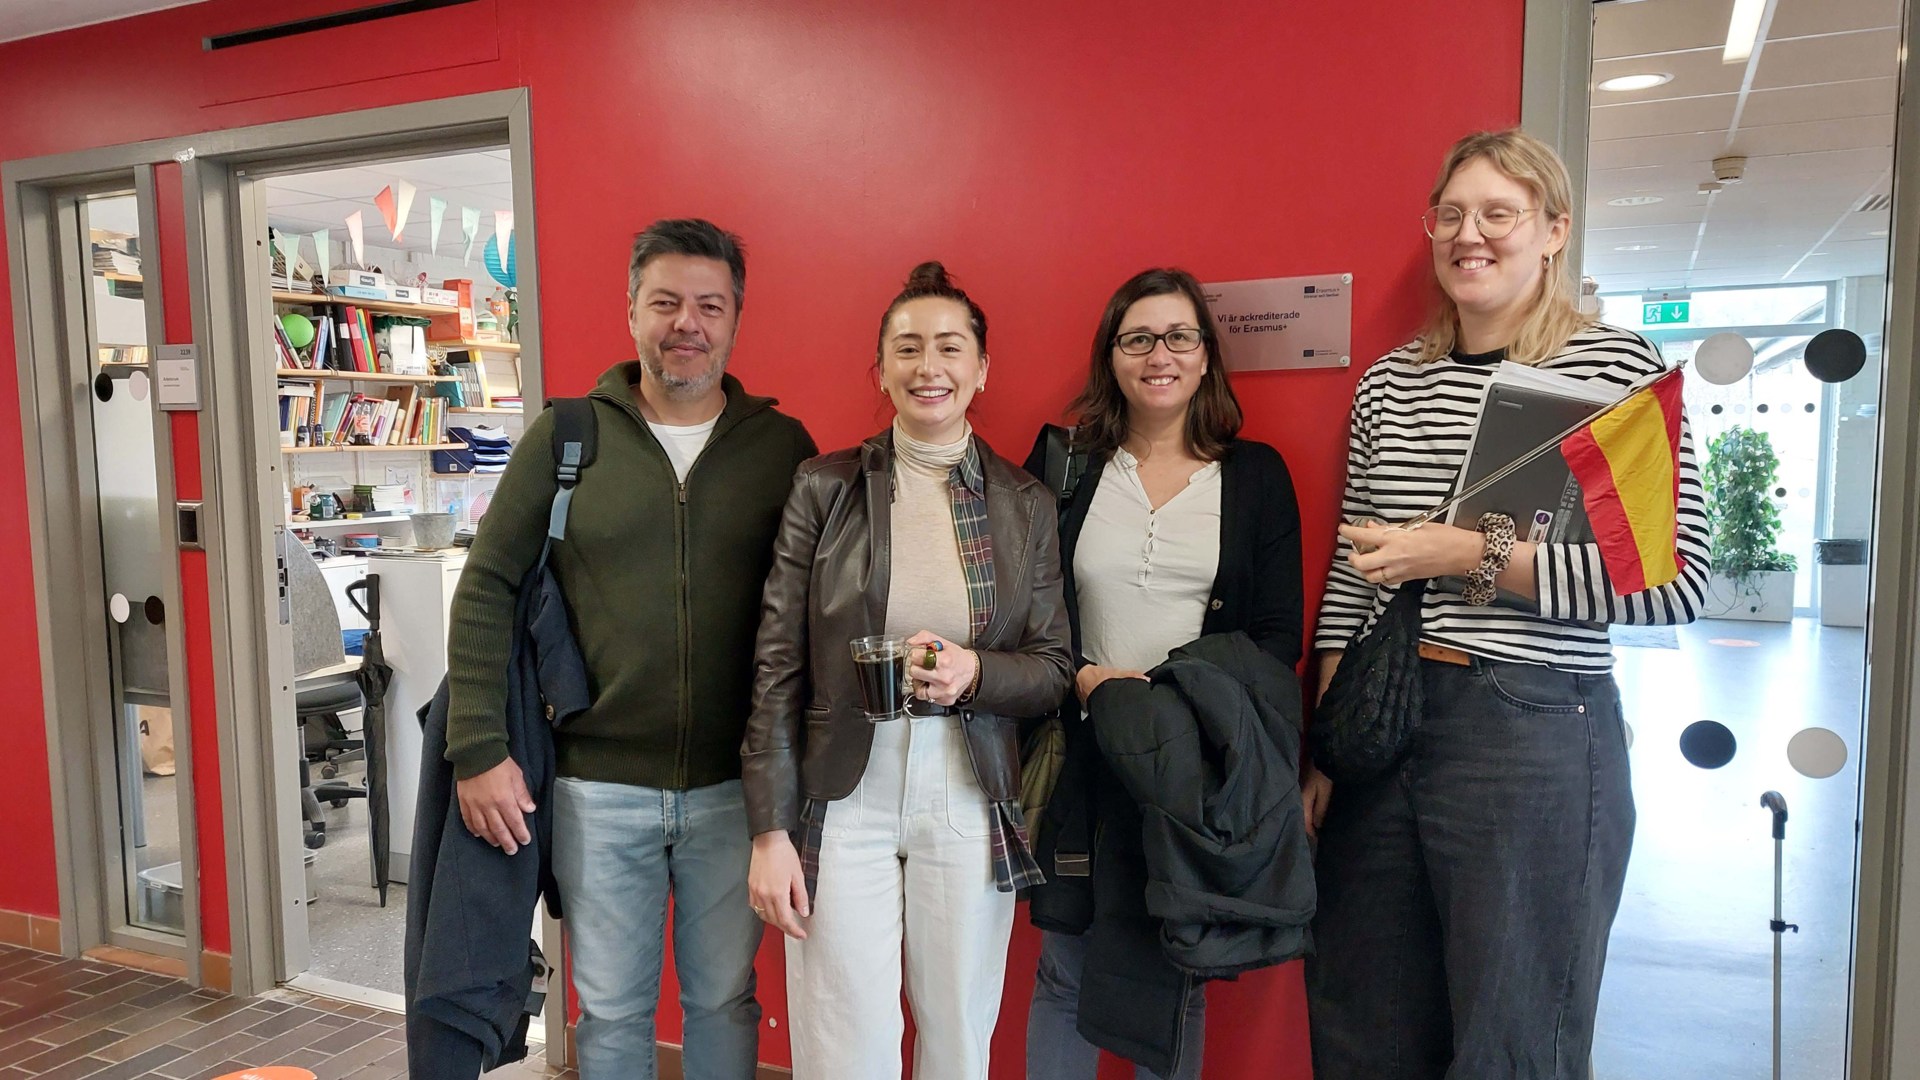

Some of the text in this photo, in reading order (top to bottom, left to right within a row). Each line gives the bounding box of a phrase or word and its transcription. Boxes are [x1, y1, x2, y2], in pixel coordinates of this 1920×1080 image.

[1217, 310, 1300, 323] Vi är ackrediterade
[1229, 323, 1287, 334] för Erasmus+
